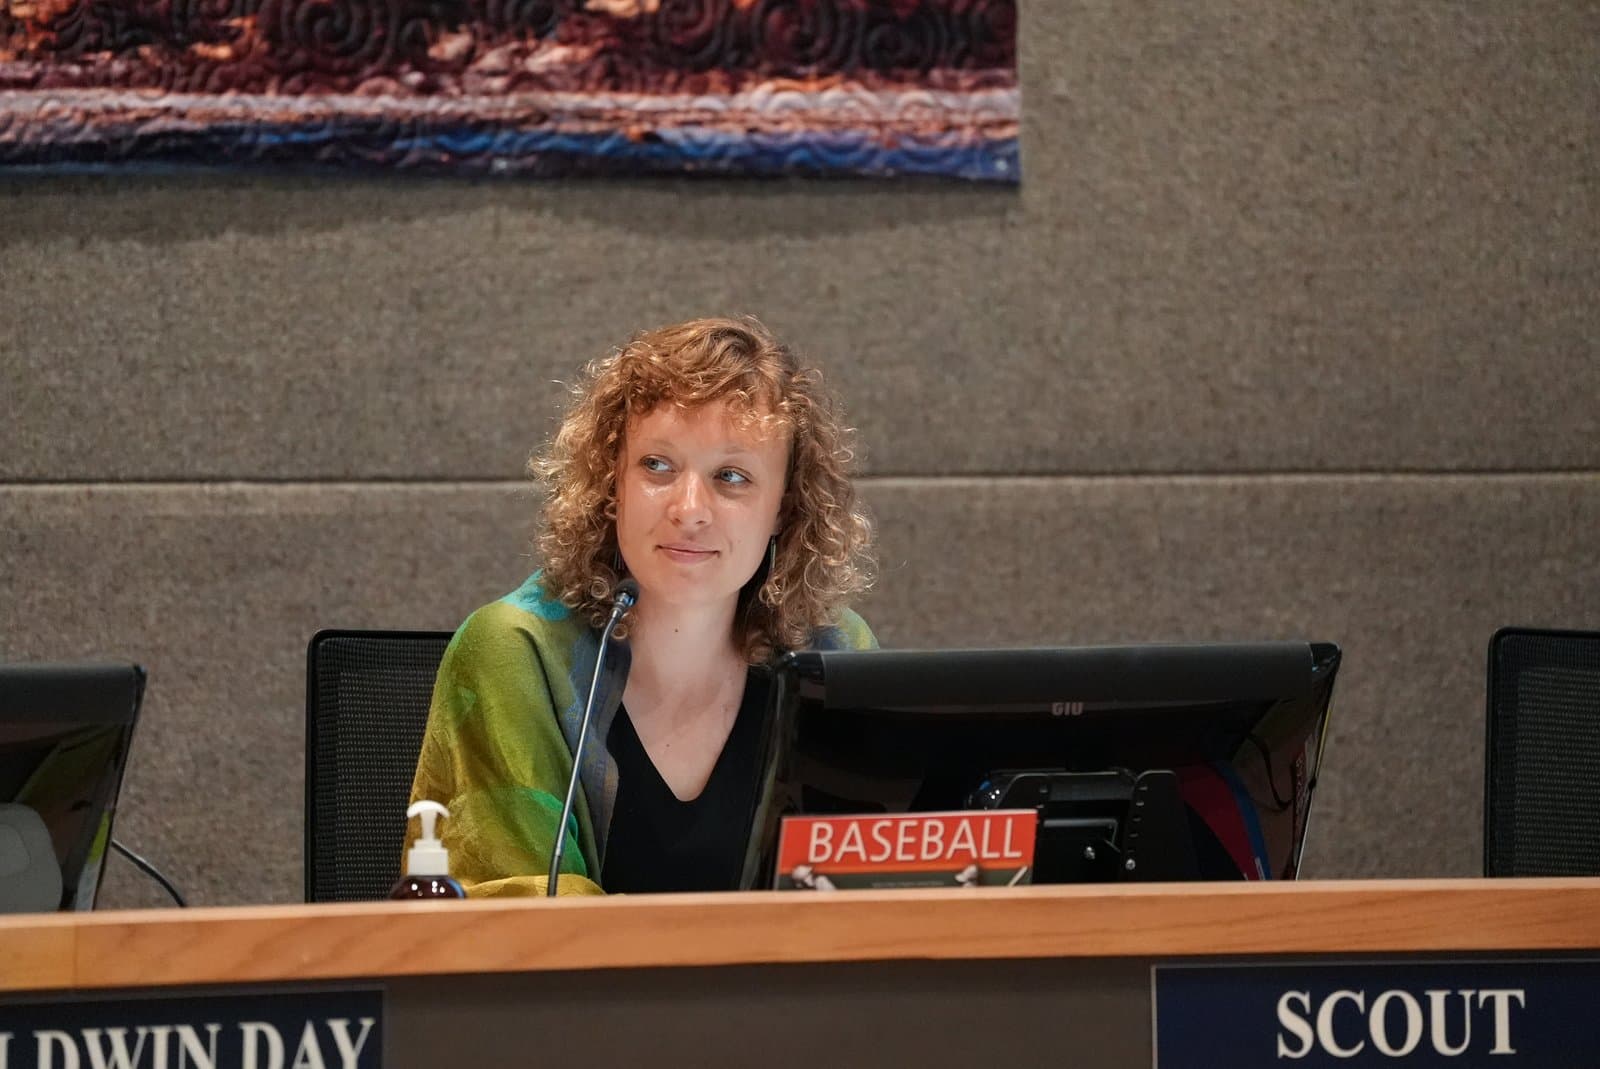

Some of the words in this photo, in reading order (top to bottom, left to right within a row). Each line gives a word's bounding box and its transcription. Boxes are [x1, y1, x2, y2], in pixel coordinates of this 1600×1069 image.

[807, 817, 1022, 863] BASEBALL
[238, 1017, 375, 1069] DAY
[1276, 989, 1526, 1059] SCOUT
